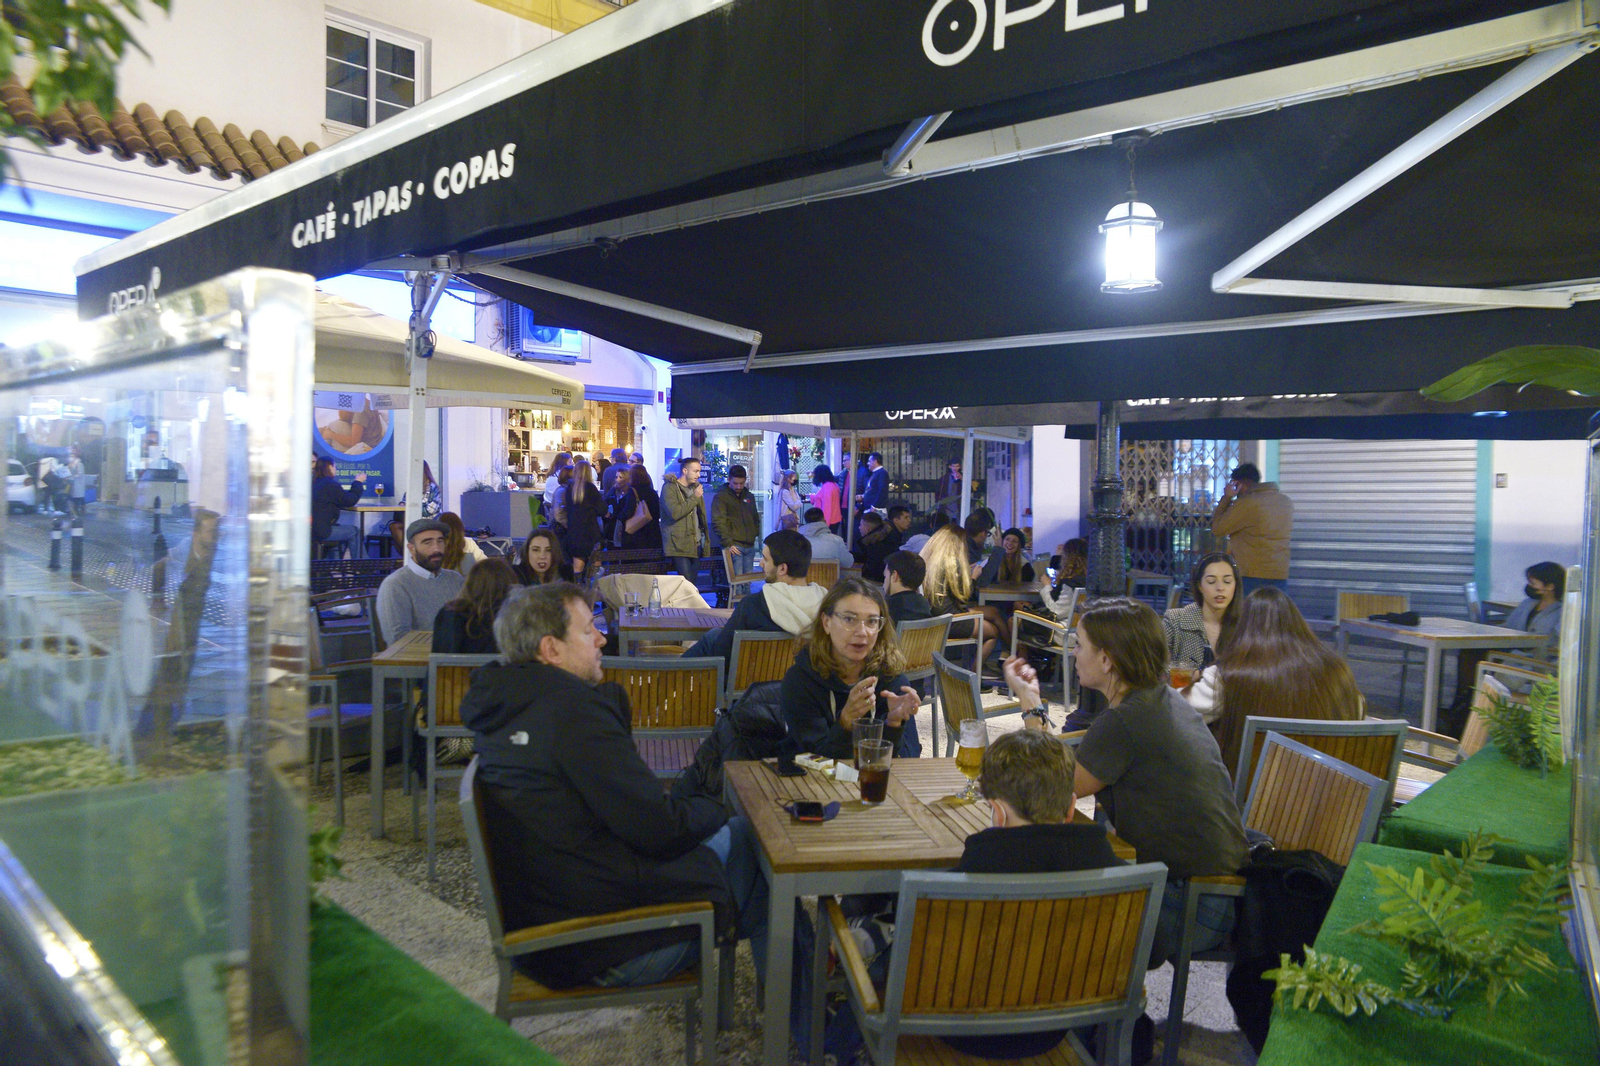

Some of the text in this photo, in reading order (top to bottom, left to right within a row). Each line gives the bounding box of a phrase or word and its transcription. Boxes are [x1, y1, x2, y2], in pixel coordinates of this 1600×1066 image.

[291, 143, 517, 248] CAFÉ TAPAS COPAS
